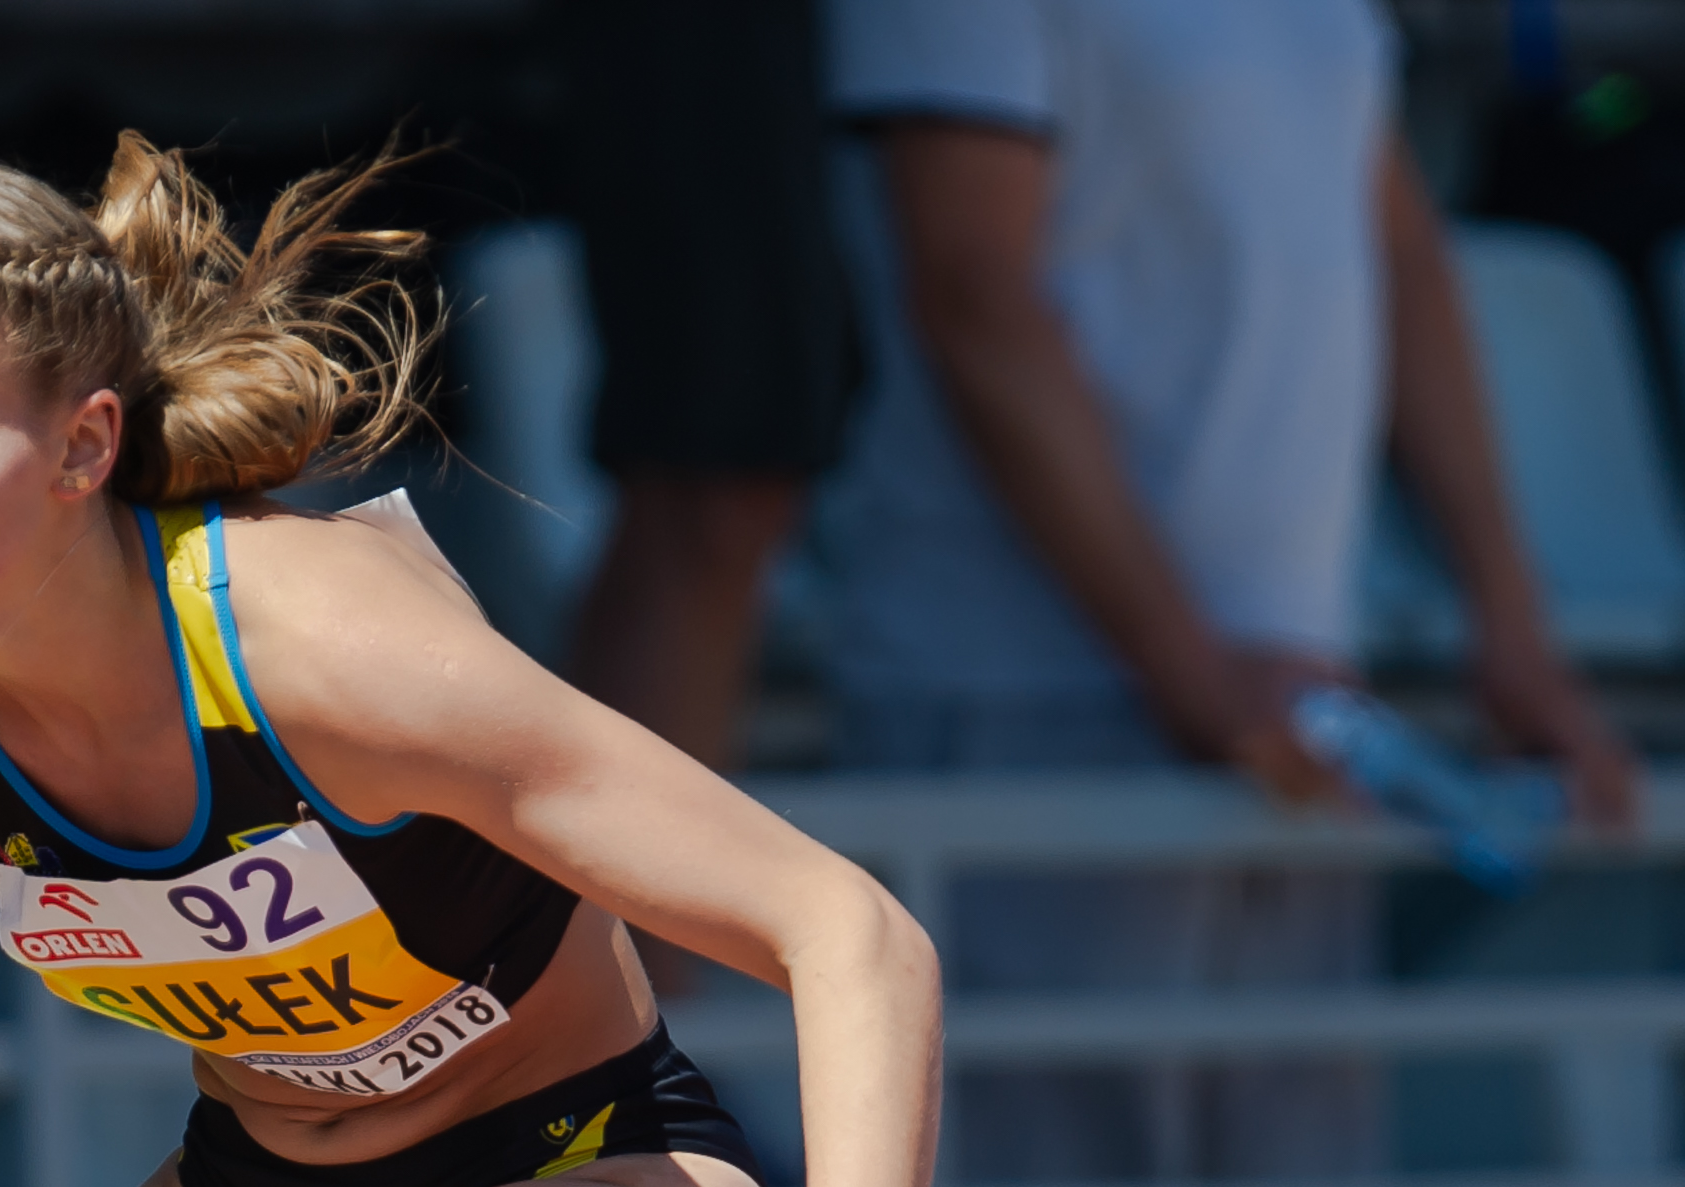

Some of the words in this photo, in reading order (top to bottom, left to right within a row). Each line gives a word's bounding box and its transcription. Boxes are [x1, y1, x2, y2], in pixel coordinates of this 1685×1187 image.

[19, 933, 132, 958] ORLEN
[167, 856, 324, 953] 92
[81, 952, 405, 1042] SUŁEK
[378, 994, 496, 1082] 2018
